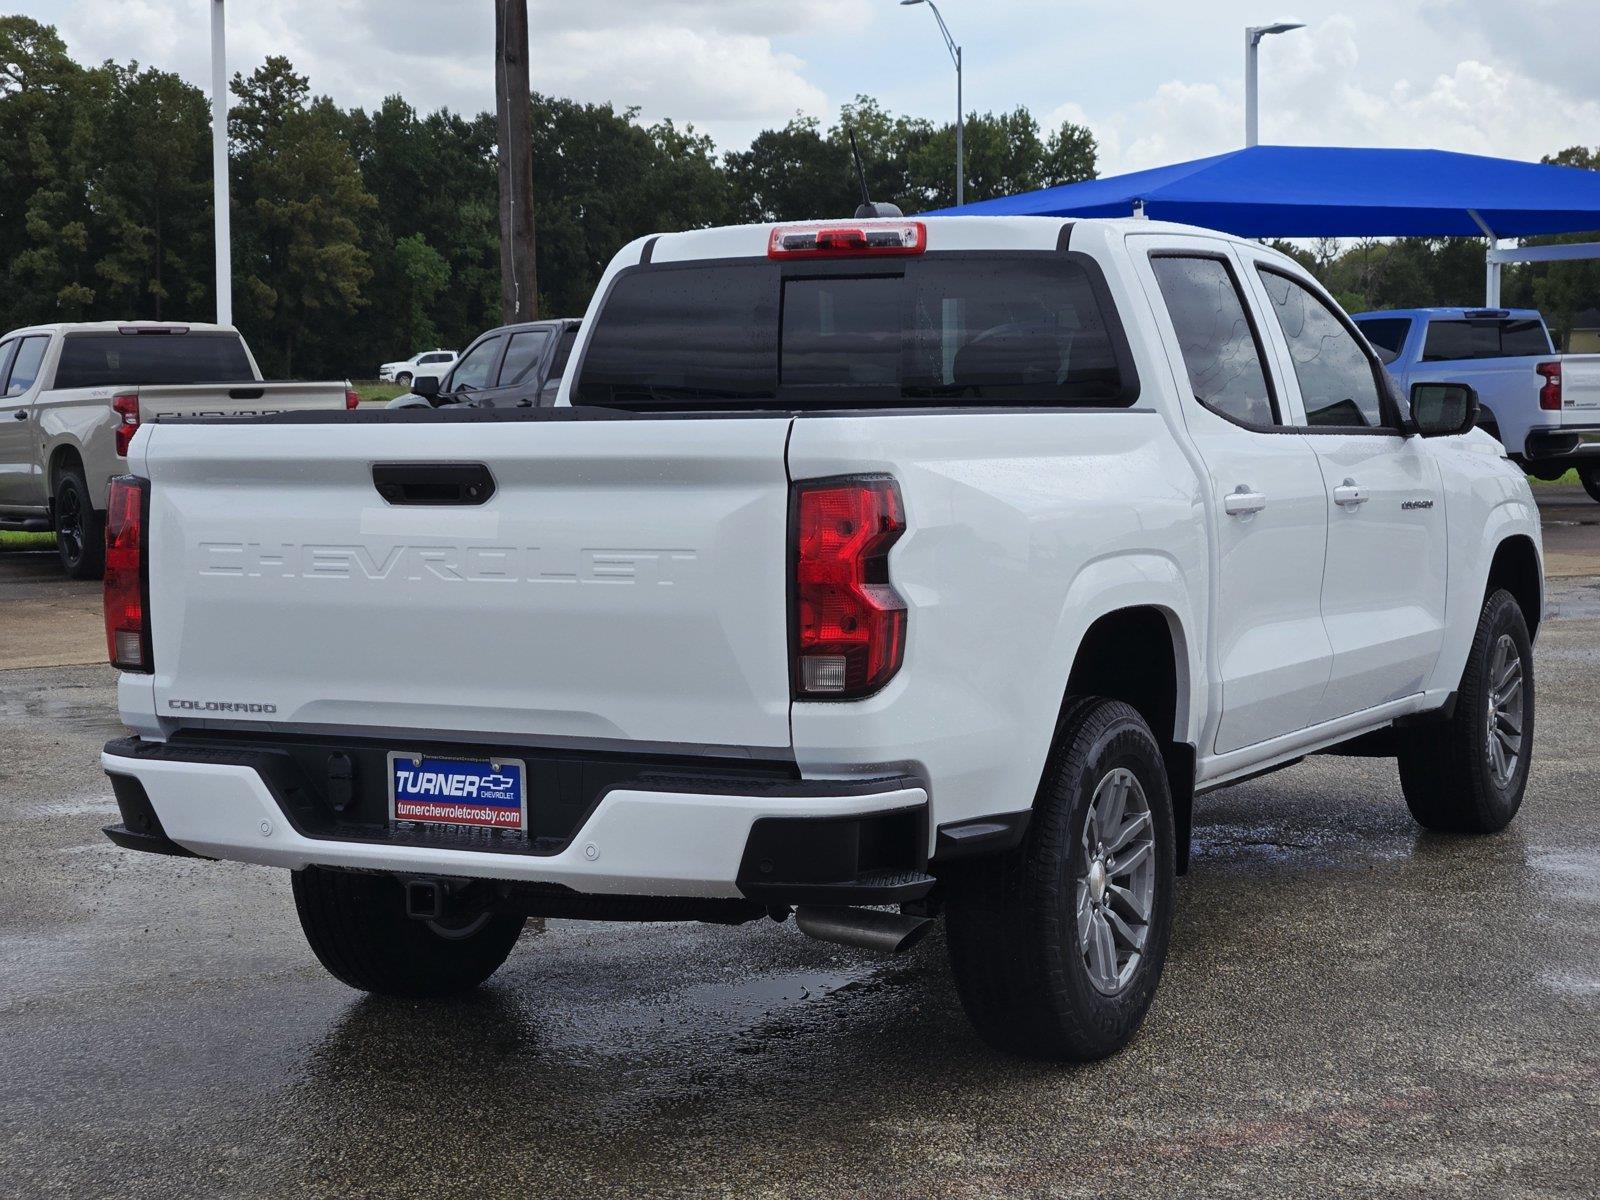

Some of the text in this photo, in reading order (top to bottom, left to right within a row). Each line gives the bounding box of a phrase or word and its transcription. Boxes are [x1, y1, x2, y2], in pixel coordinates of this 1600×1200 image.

[198, 541, 697, 585] CHEVROLET
[168, 699, 277, 714] COLORADO
[396, 770, 481, 798] TURNER
[480, 790, 514, 800] CHEVROLET
[397, 802, 520, 824] turnerchevroletcrosby.com
